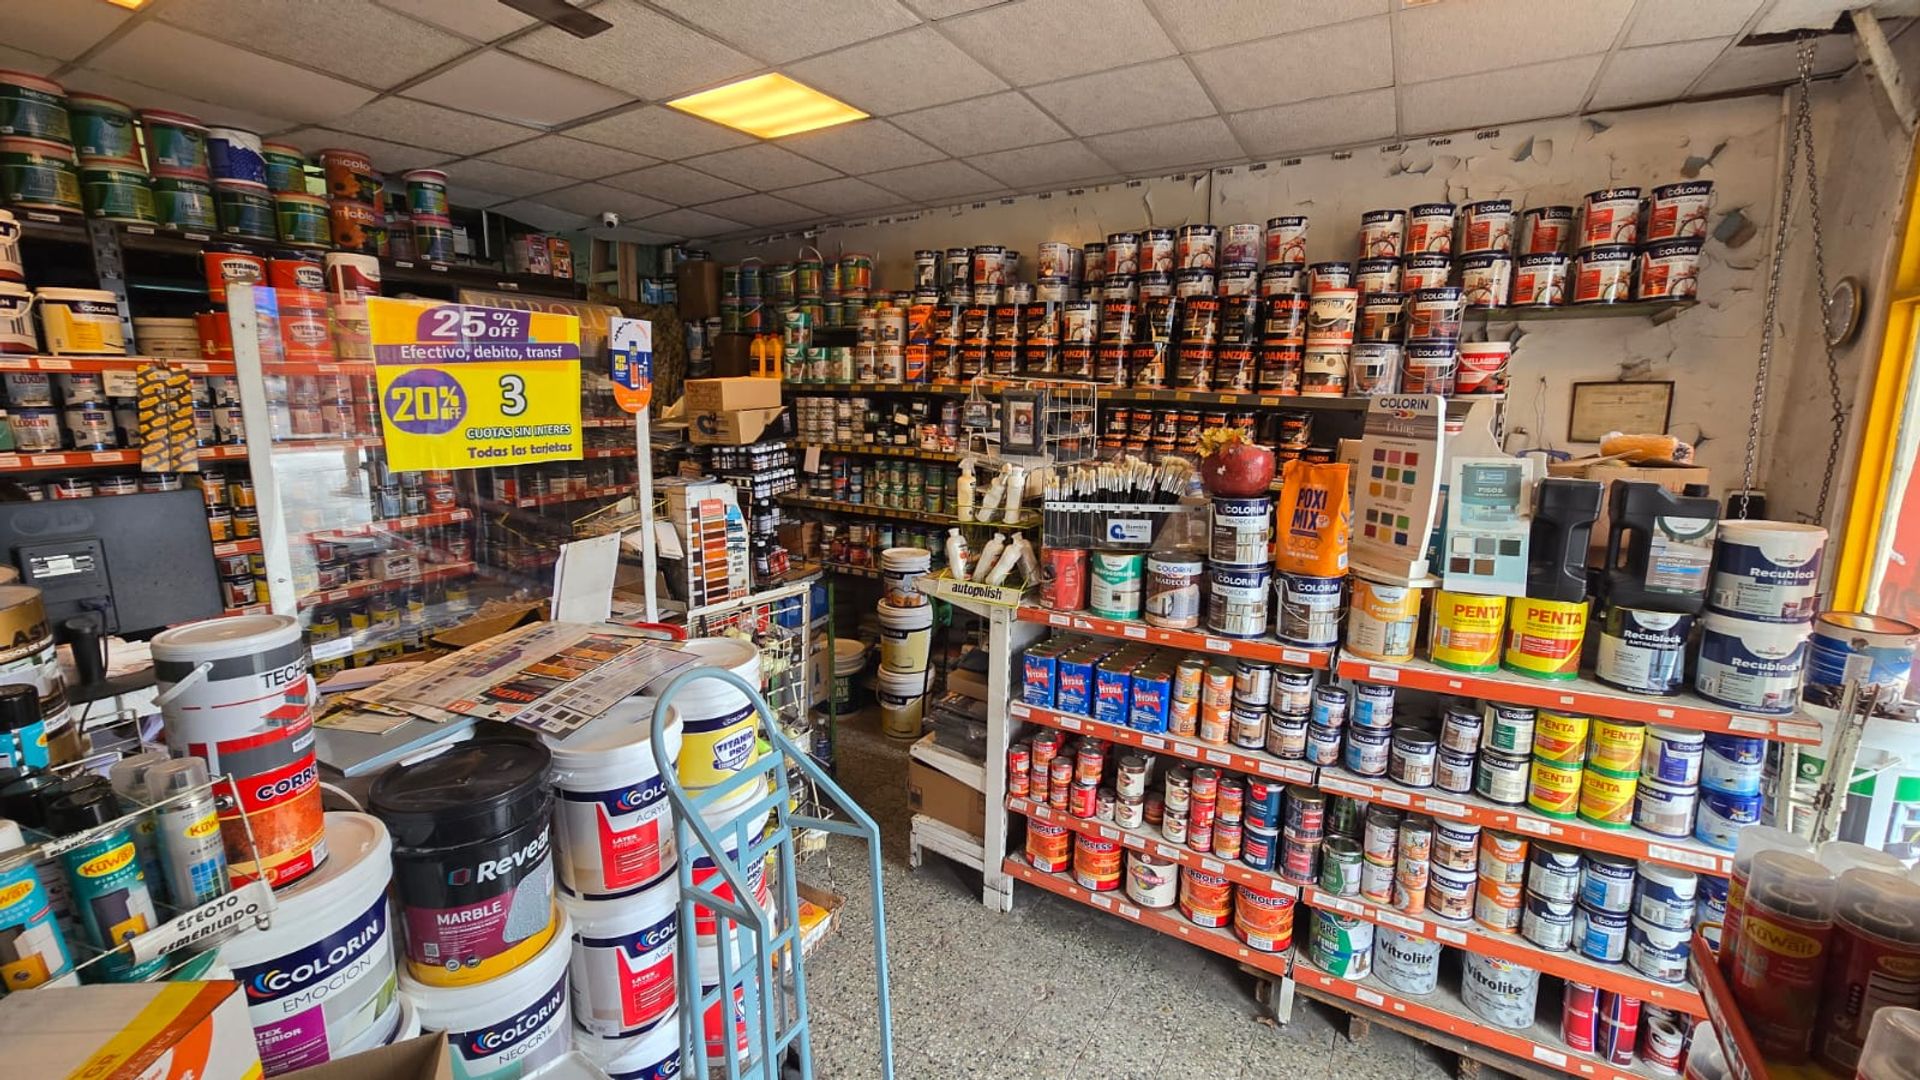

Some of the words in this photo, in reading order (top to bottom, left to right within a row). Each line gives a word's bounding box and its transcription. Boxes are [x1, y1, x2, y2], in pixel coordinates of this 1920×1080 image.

[488, 326, 520, 338] OFF
[401, 345, 471, 362] Efectivo,
[474, 345, 524, 361] debito,
[526, 345, 563, 359] transf
[498, 373, 527, 416] 3
[1380, 398, 1430, 410] COLORIN
[12, 418, 49, 429] LOXON
[465, 425, 512, 440] CUOTAS
[514, 424, 533, 438] SIN
[534, 423, 572, 437] INTERES
[467, 445, 508, 459] Todas
[511, 443, 527, 457] las
[530, 442, 573, 457] tarjetas
[1297, 488, 1328, 510] POXI
[1224, 504, 1266, 516] COLORIN
[1291, 510, 1319, 531] MIX
[1155, 563, 1193, 574] COLORIN
[1217, 574, 1260, 586] COLORIN
[951, 583, 1003, 601] autopolish
[1453, 604, 1502, 619] PENTA
[1527, 608, 1582, 626] PENTA
[1624, 630, 1681, 644] Recublock
[729, 744, 748, 757] PRO
[1536, 768, 1573, 783] PENTA
[477, 824, 550, 884] Revear
[177, 895, 239, 932] EFECTO
[437, 901, 502, 926] MARBLE
[159, 903, 259, 955] ESMERILADO
[267, 920, 379, 990] COLORIN
[1381, 938, 1433, 965] Vitrolite
[283, 957, 373, 1014] EMOCION
[1468, 962, 1525, 996] Vitrolite
[487, 992, 561, 1049] COLORIN
